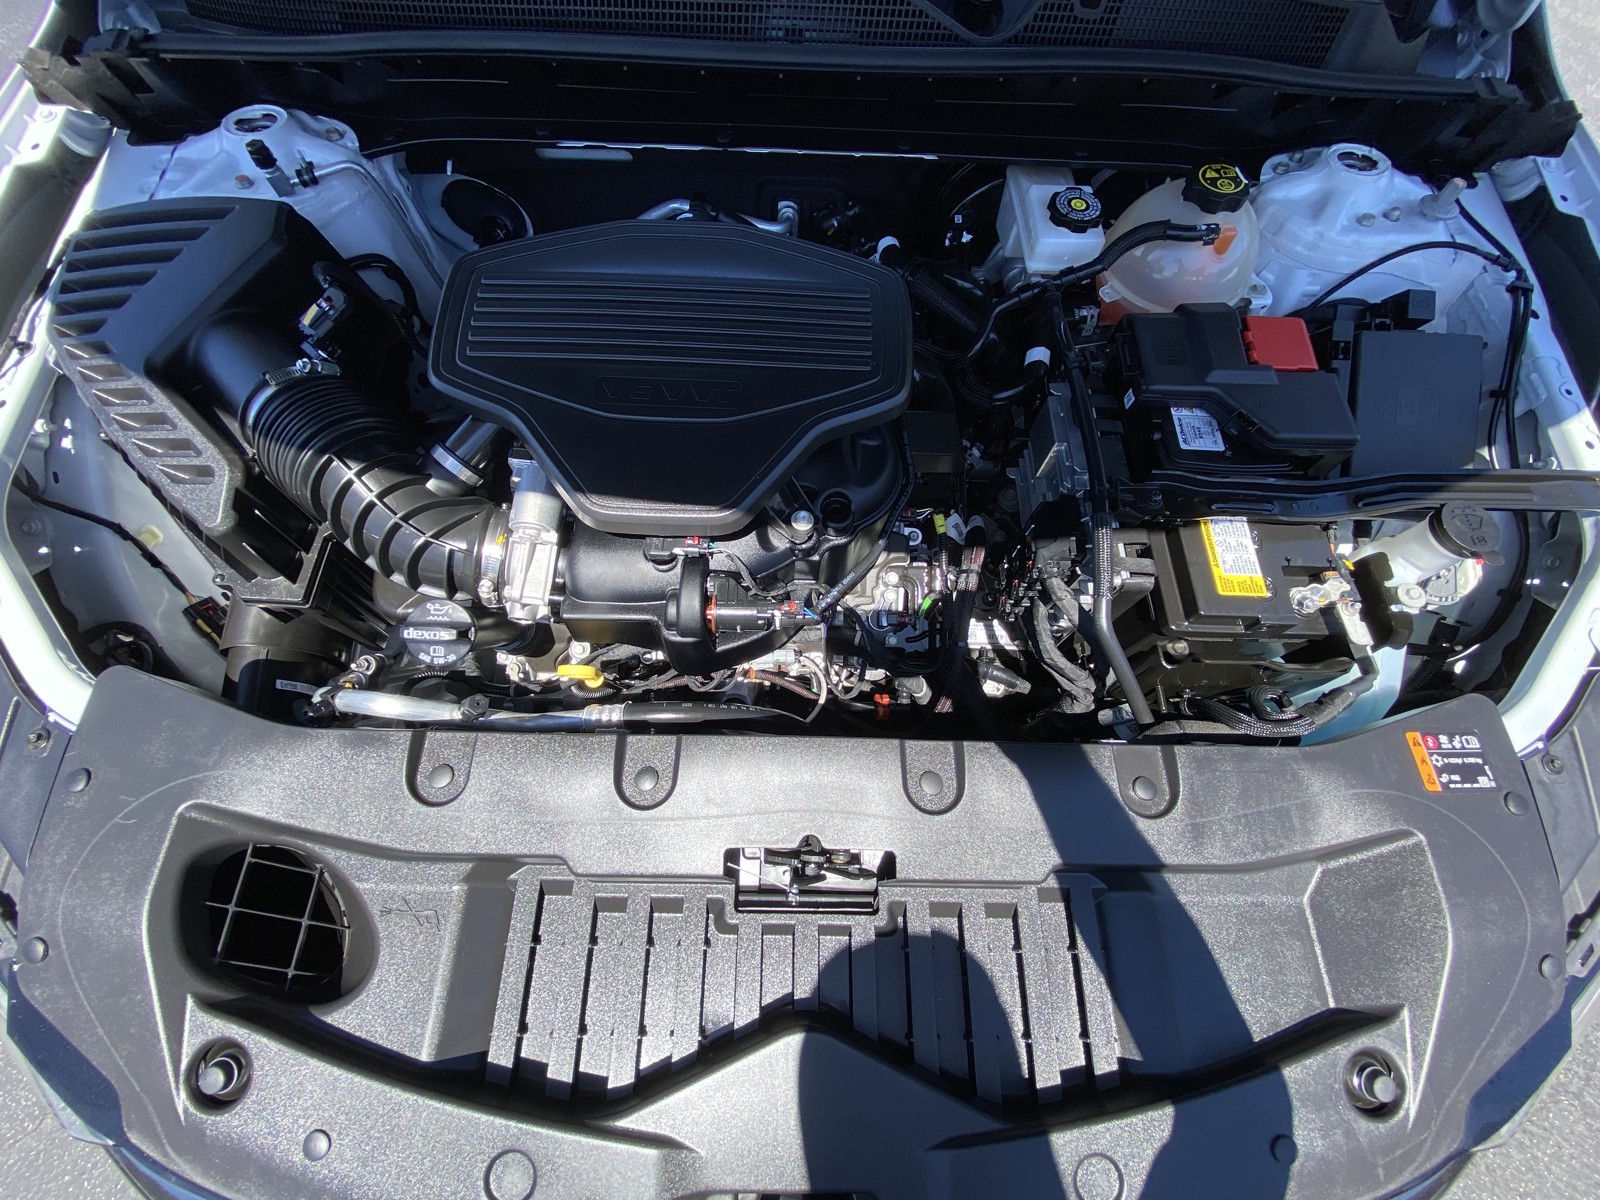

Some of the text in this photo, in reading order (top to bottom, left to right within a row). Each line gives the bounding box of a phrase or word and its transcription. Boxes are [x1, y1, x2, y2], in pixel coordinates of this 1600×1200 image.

[1177, 417, 1189, 446] ACDelco
[403, 627, 449, 640] dexos
[418, 652, 457, 665] SAE 5W-30
